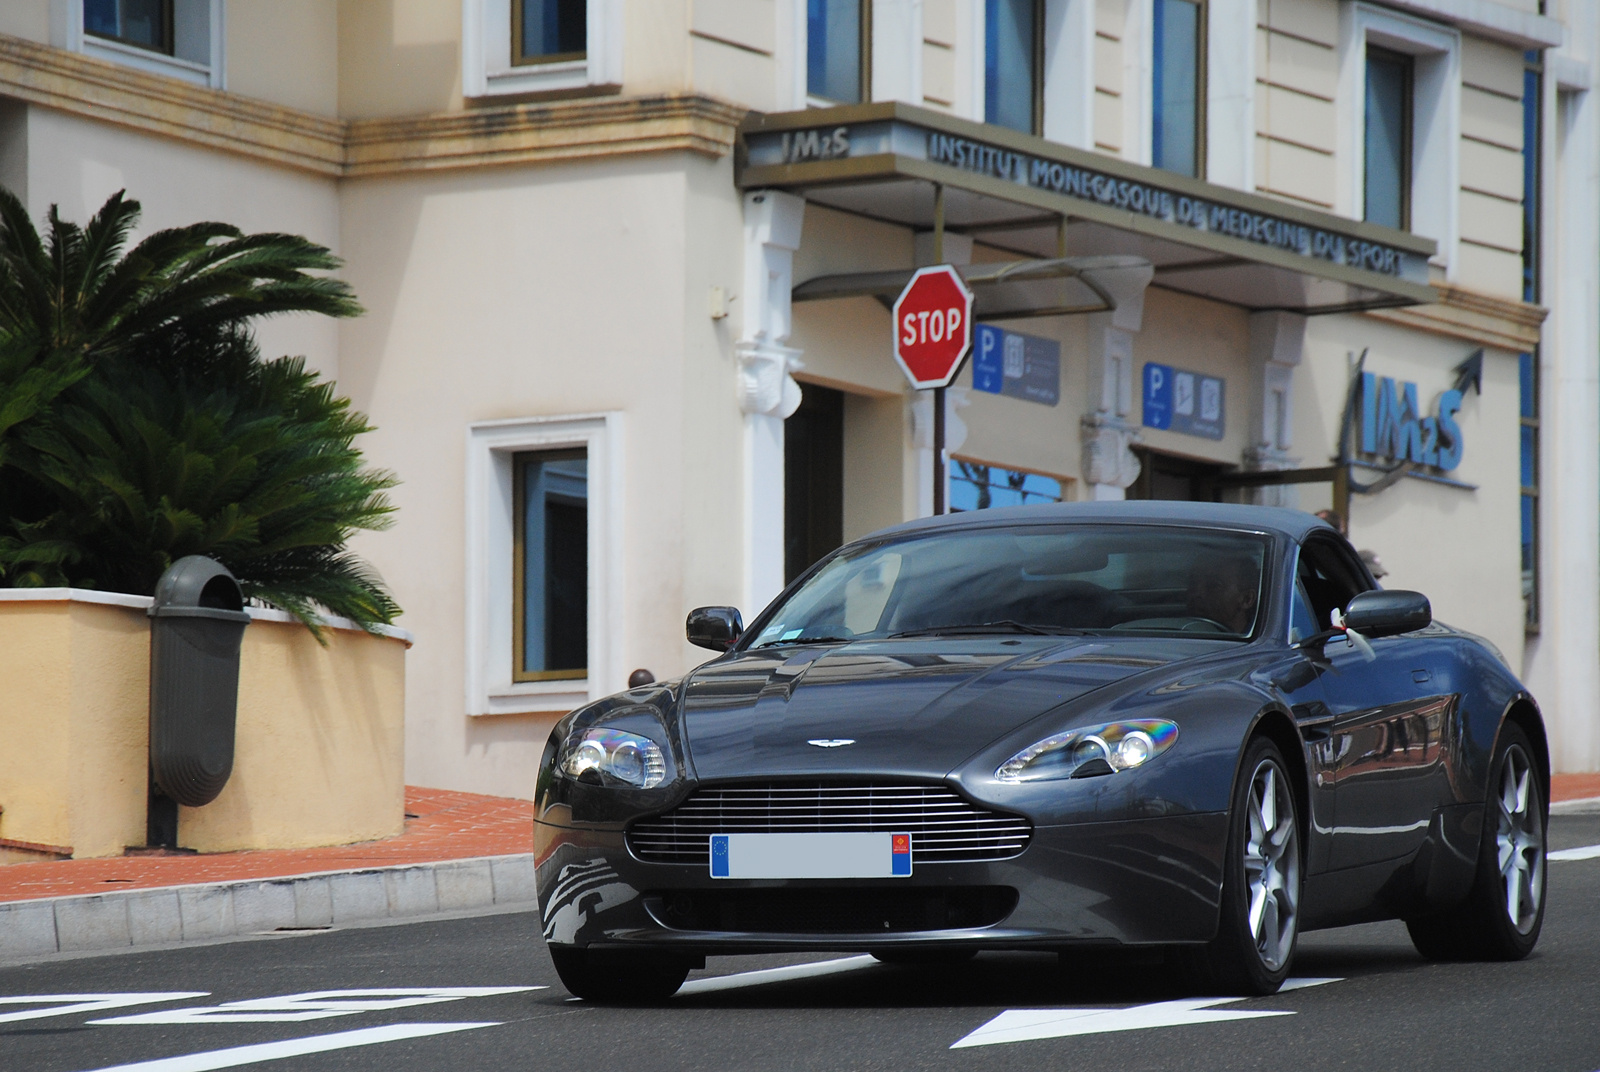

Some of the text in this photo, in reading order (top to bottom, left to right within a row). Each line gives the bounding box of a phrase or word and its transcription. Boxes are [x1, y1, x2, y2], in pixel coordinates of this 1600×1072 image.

[930, 133, 1402, 276] INSTITUT MONEGASQUE DE MEDECINE DU SPORT
[903, 308, 962, 346] STOP
[981, 329, 995, 361] P
[1150, 367, 1163, 399] P
